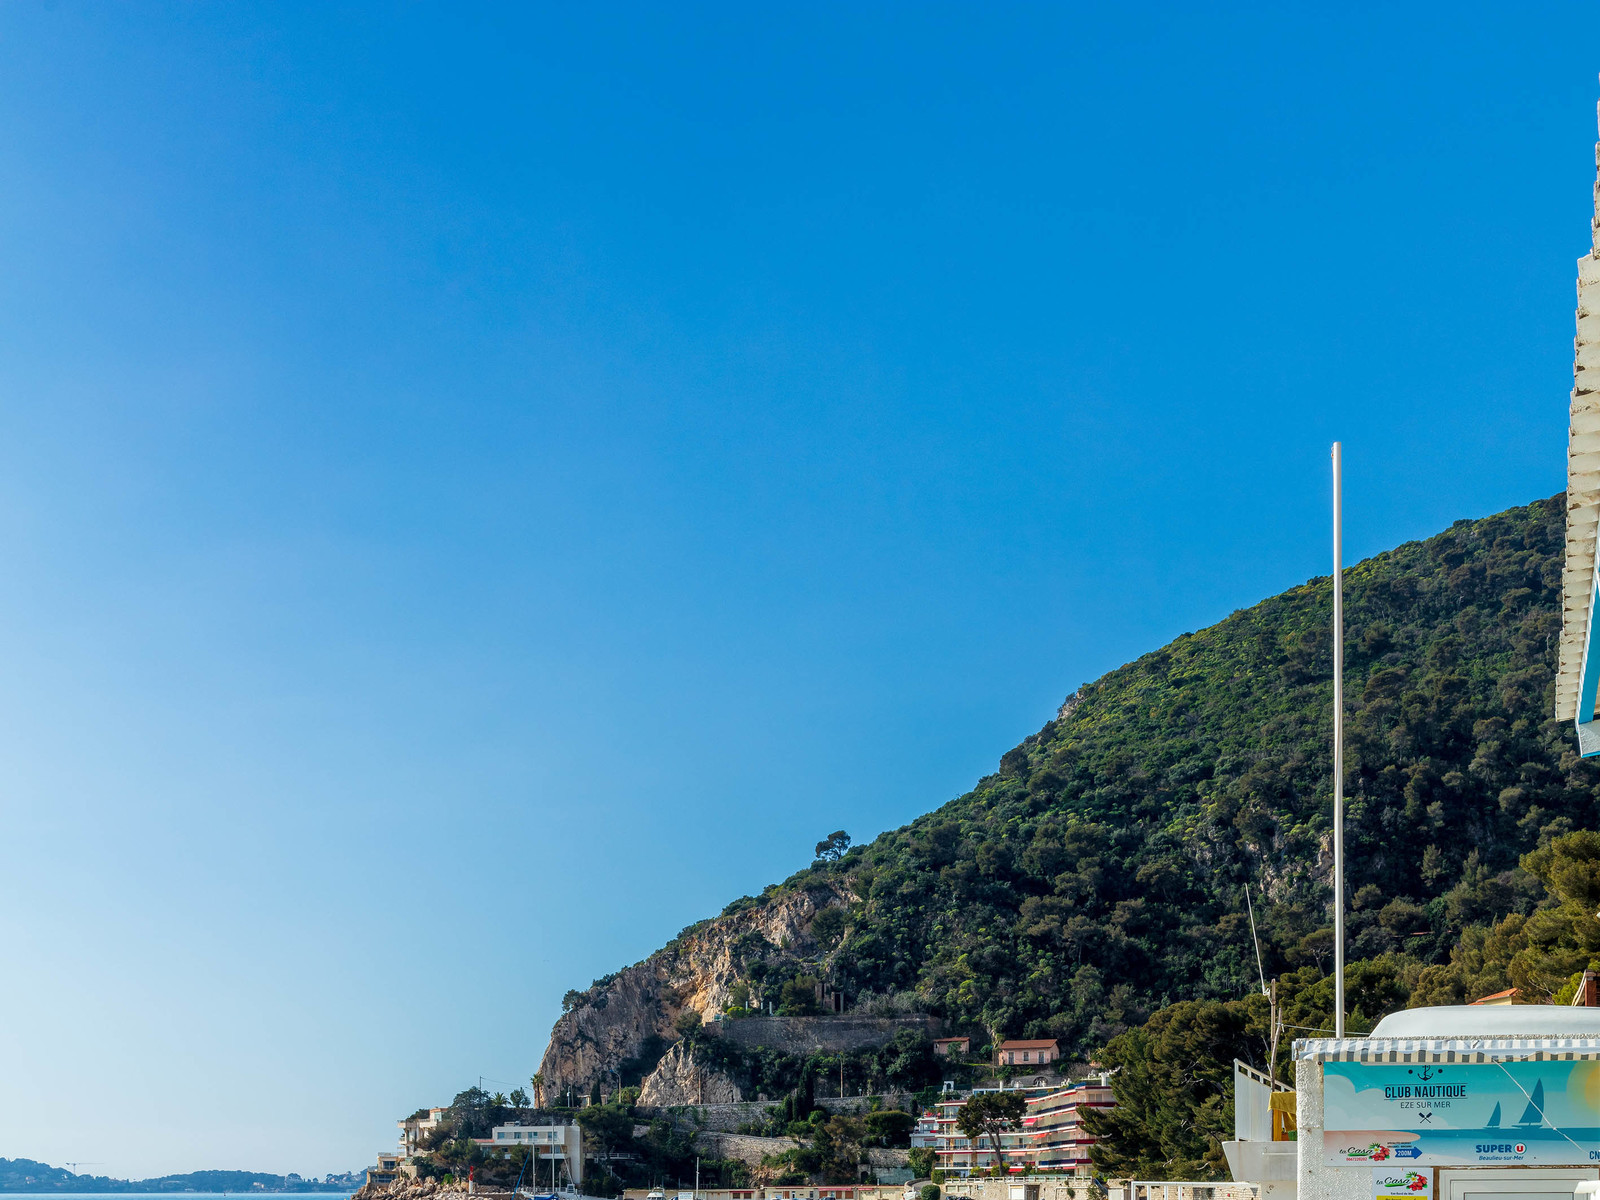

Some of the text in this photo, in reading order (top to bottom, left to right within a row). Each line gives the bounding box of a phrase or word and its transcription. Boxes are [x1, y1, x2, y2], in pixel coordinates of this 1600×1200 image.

[1385, 1085, 1466, 1098] CLUB NAUTIQUE
[1400, 1101, 1414, 1109] EZE
[1434, 1100, 1451, 1108] MER
[1347, 1146, 1373, 1154] Casa
[1476, 1144, 1512, 1153] SUPER
[1384, 1177, 1411, 1185] Casa
